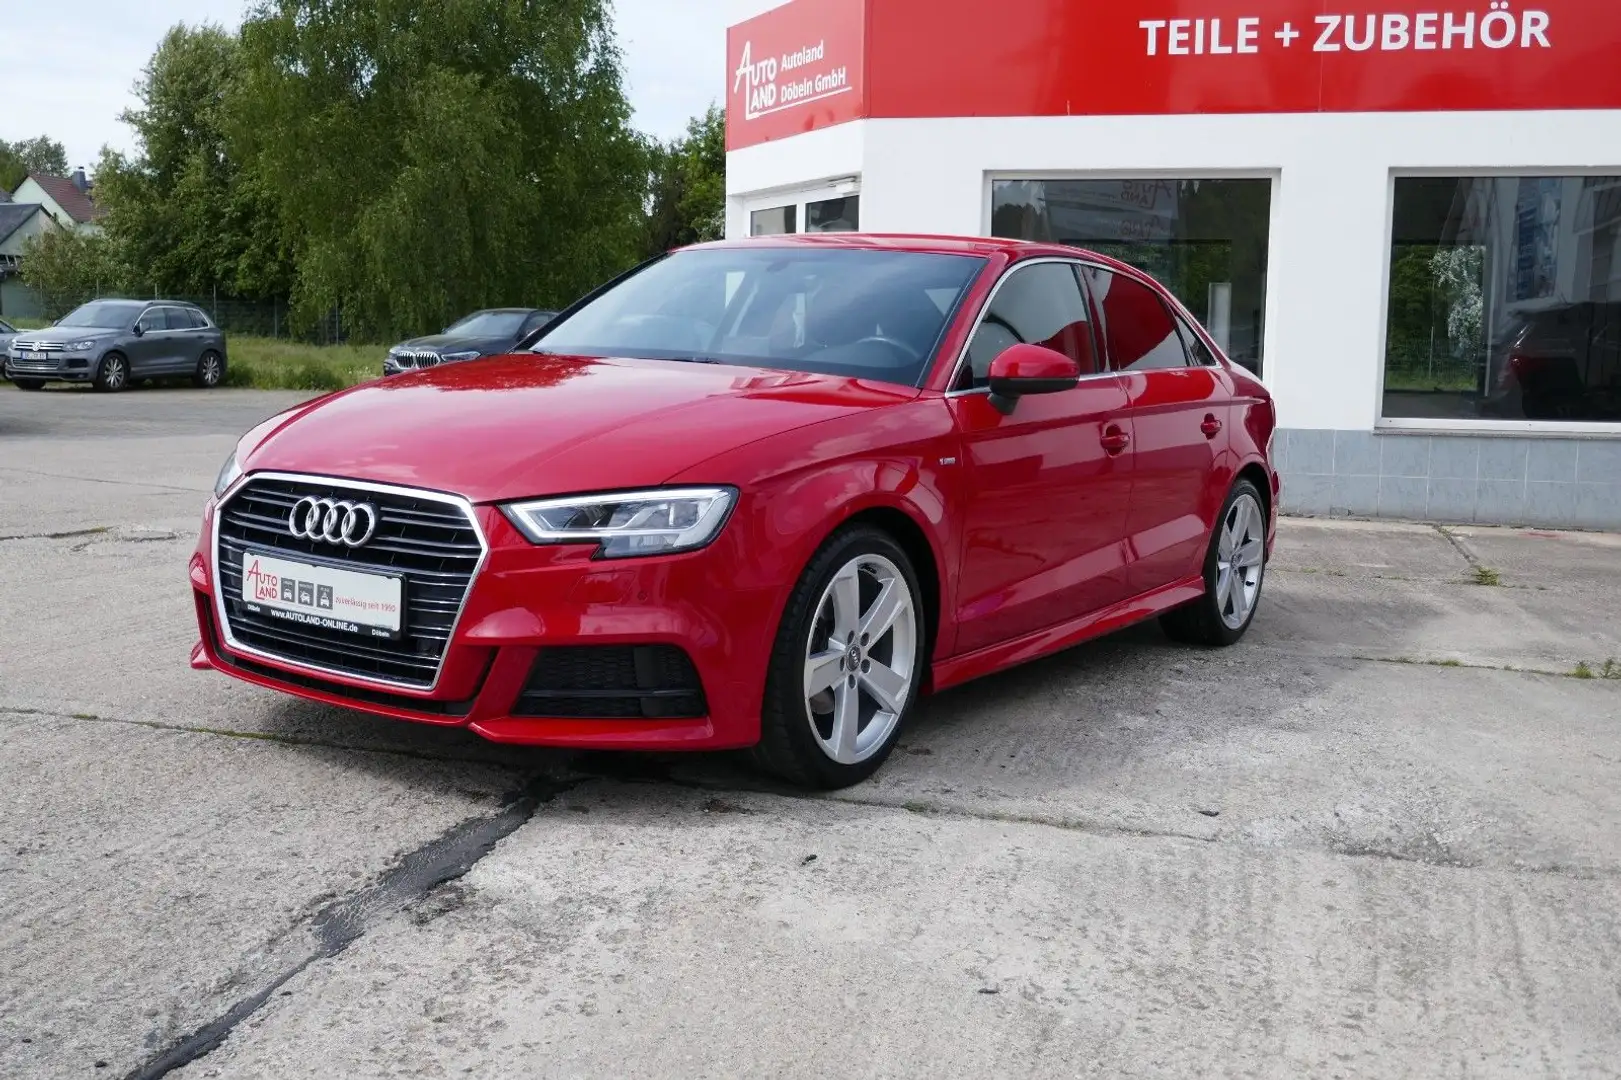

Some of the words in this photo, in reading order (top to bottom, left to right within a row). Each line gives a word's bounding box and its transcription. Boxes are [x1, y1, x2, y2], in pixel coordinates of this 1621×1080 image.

[1138, 17, 1260, 56] TEILE
[1274, 22, 1300, 48] +
[1312, 1, 1552, 53] ZUBEHÖR
[734, 40, 777, 94] AUTO
[780, 39, 824, 72] Autoland
[780, 77, 813, 103] Döbeln
[814, 66, 846, 93] GmbH
[246, 559, 278, 587] AUTO
[270, 608, 359, 633] www.AUTOLAND-ONLINE.de
